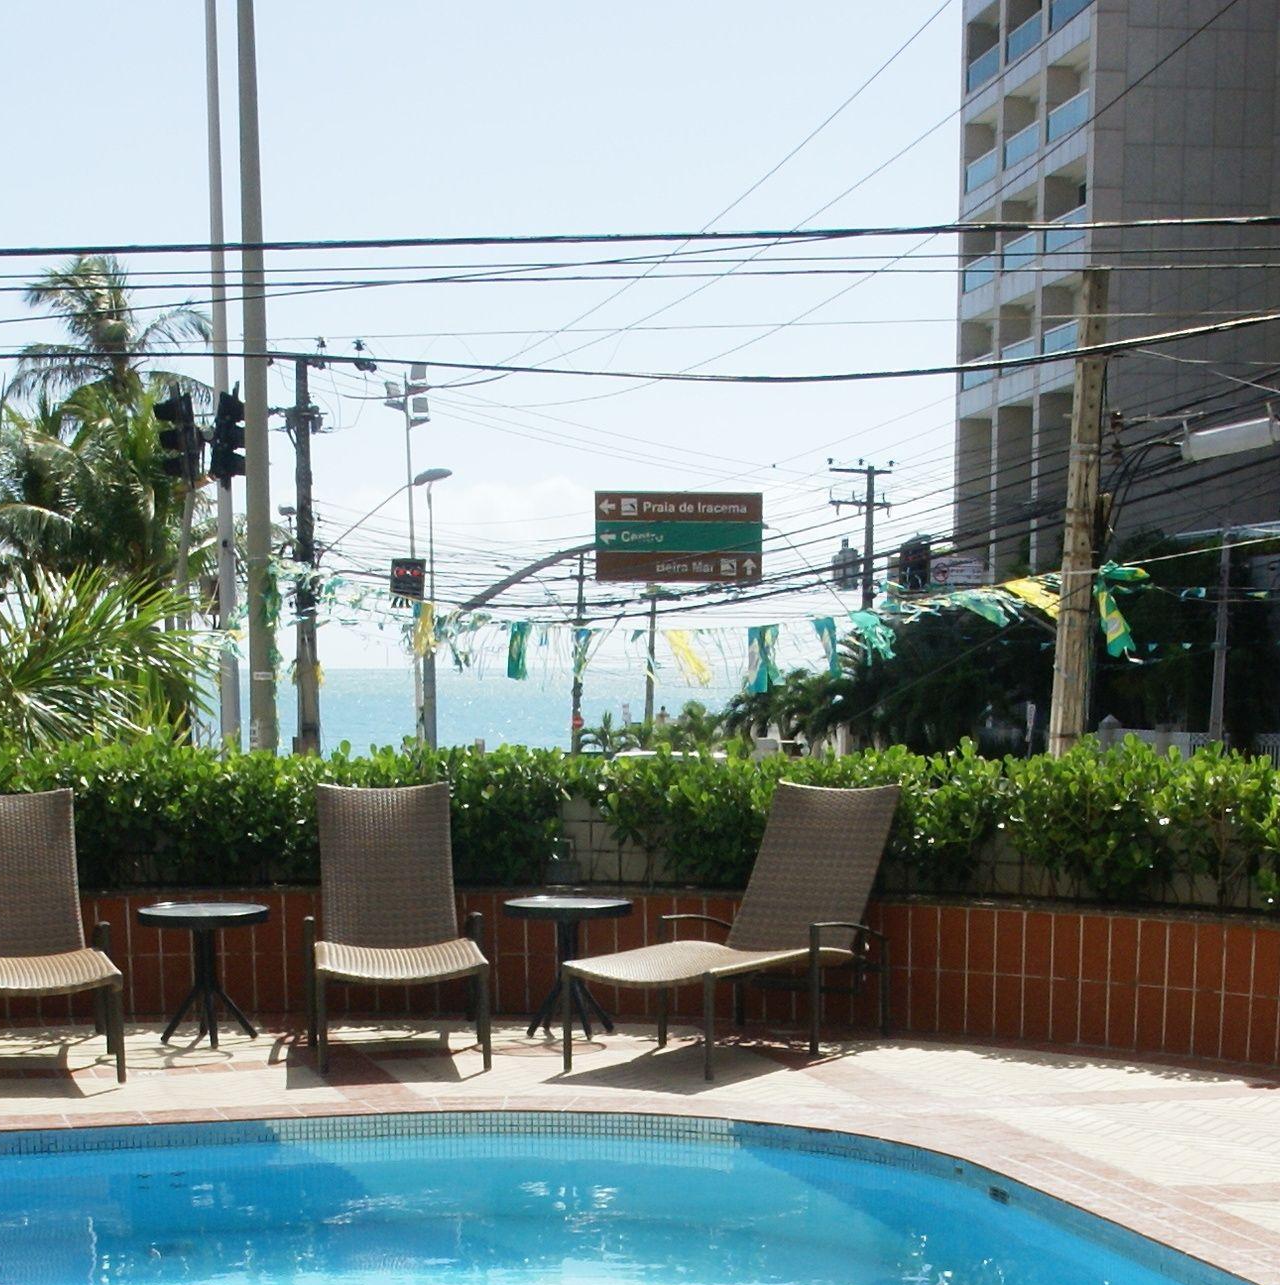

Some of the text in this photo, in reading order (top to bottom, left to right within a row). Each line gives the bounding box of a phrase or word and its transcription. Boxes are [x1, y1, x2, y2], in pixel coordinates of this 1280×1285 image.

[642, 501, 747, 514] Praia de Iracema
